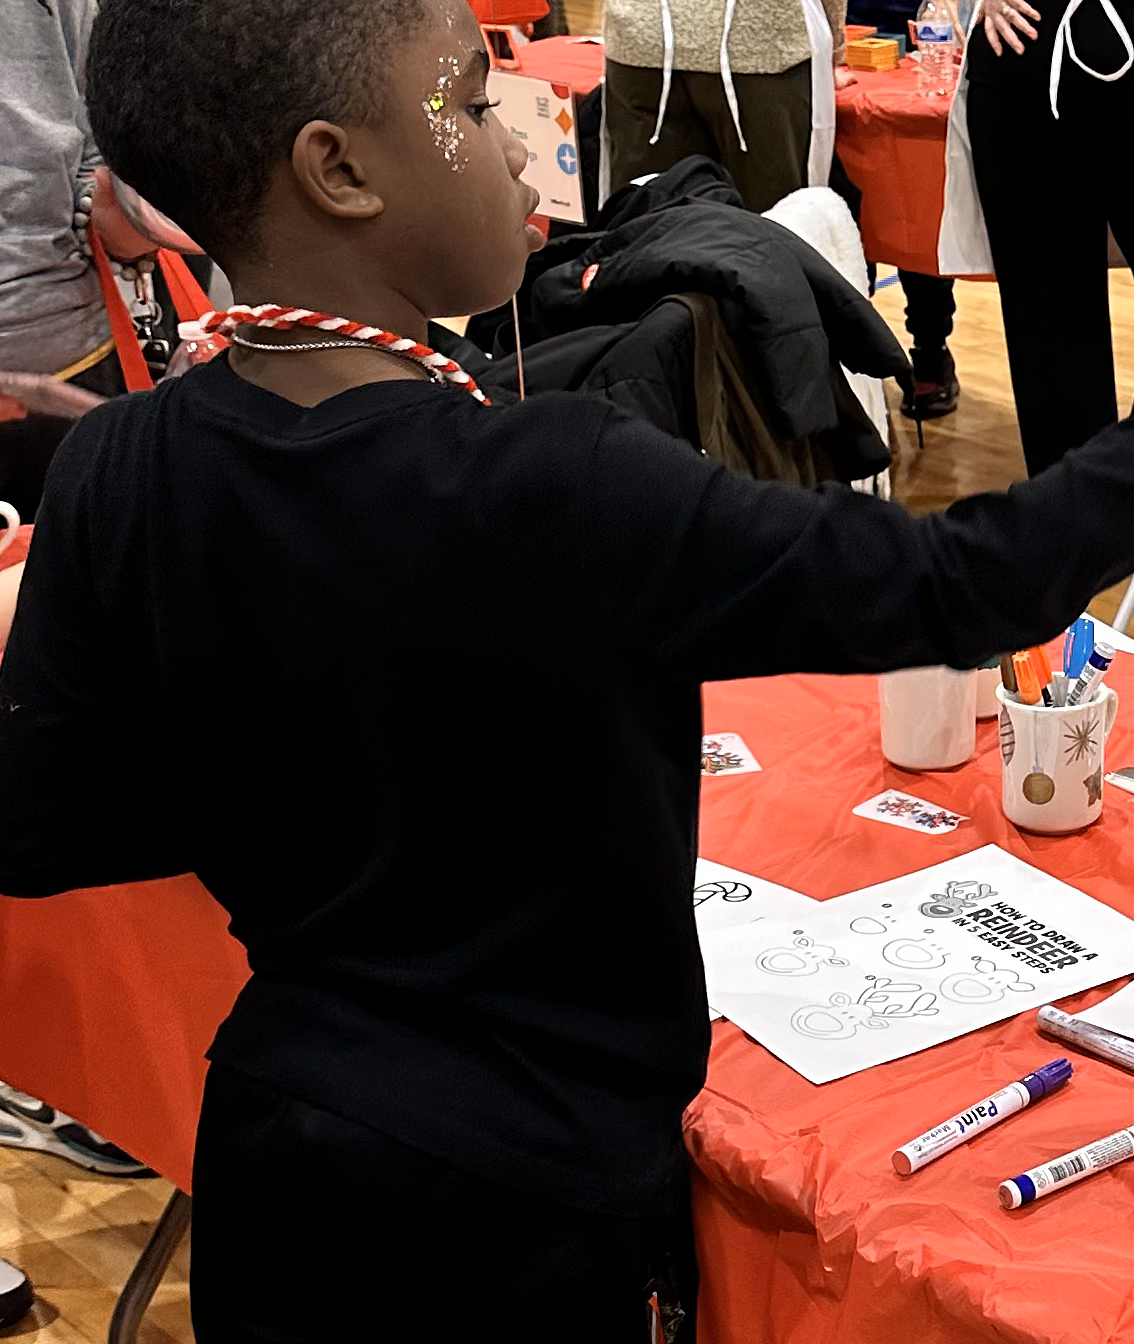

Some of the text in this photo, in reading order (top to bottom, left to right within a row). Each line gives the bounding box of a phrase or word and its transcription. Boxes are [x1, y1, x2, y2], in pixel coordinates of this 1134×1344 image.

[965, 908, 1079, 969] REINDEER
[967, 925, 982, 933] 5
[978, 931, 1015, 951] EASY
[1011, 951, 1055, 974] STEPS
[991, 901, 1099, 961] HOW TO DRAW A
[955, 1100, 999, 1134] Paint
